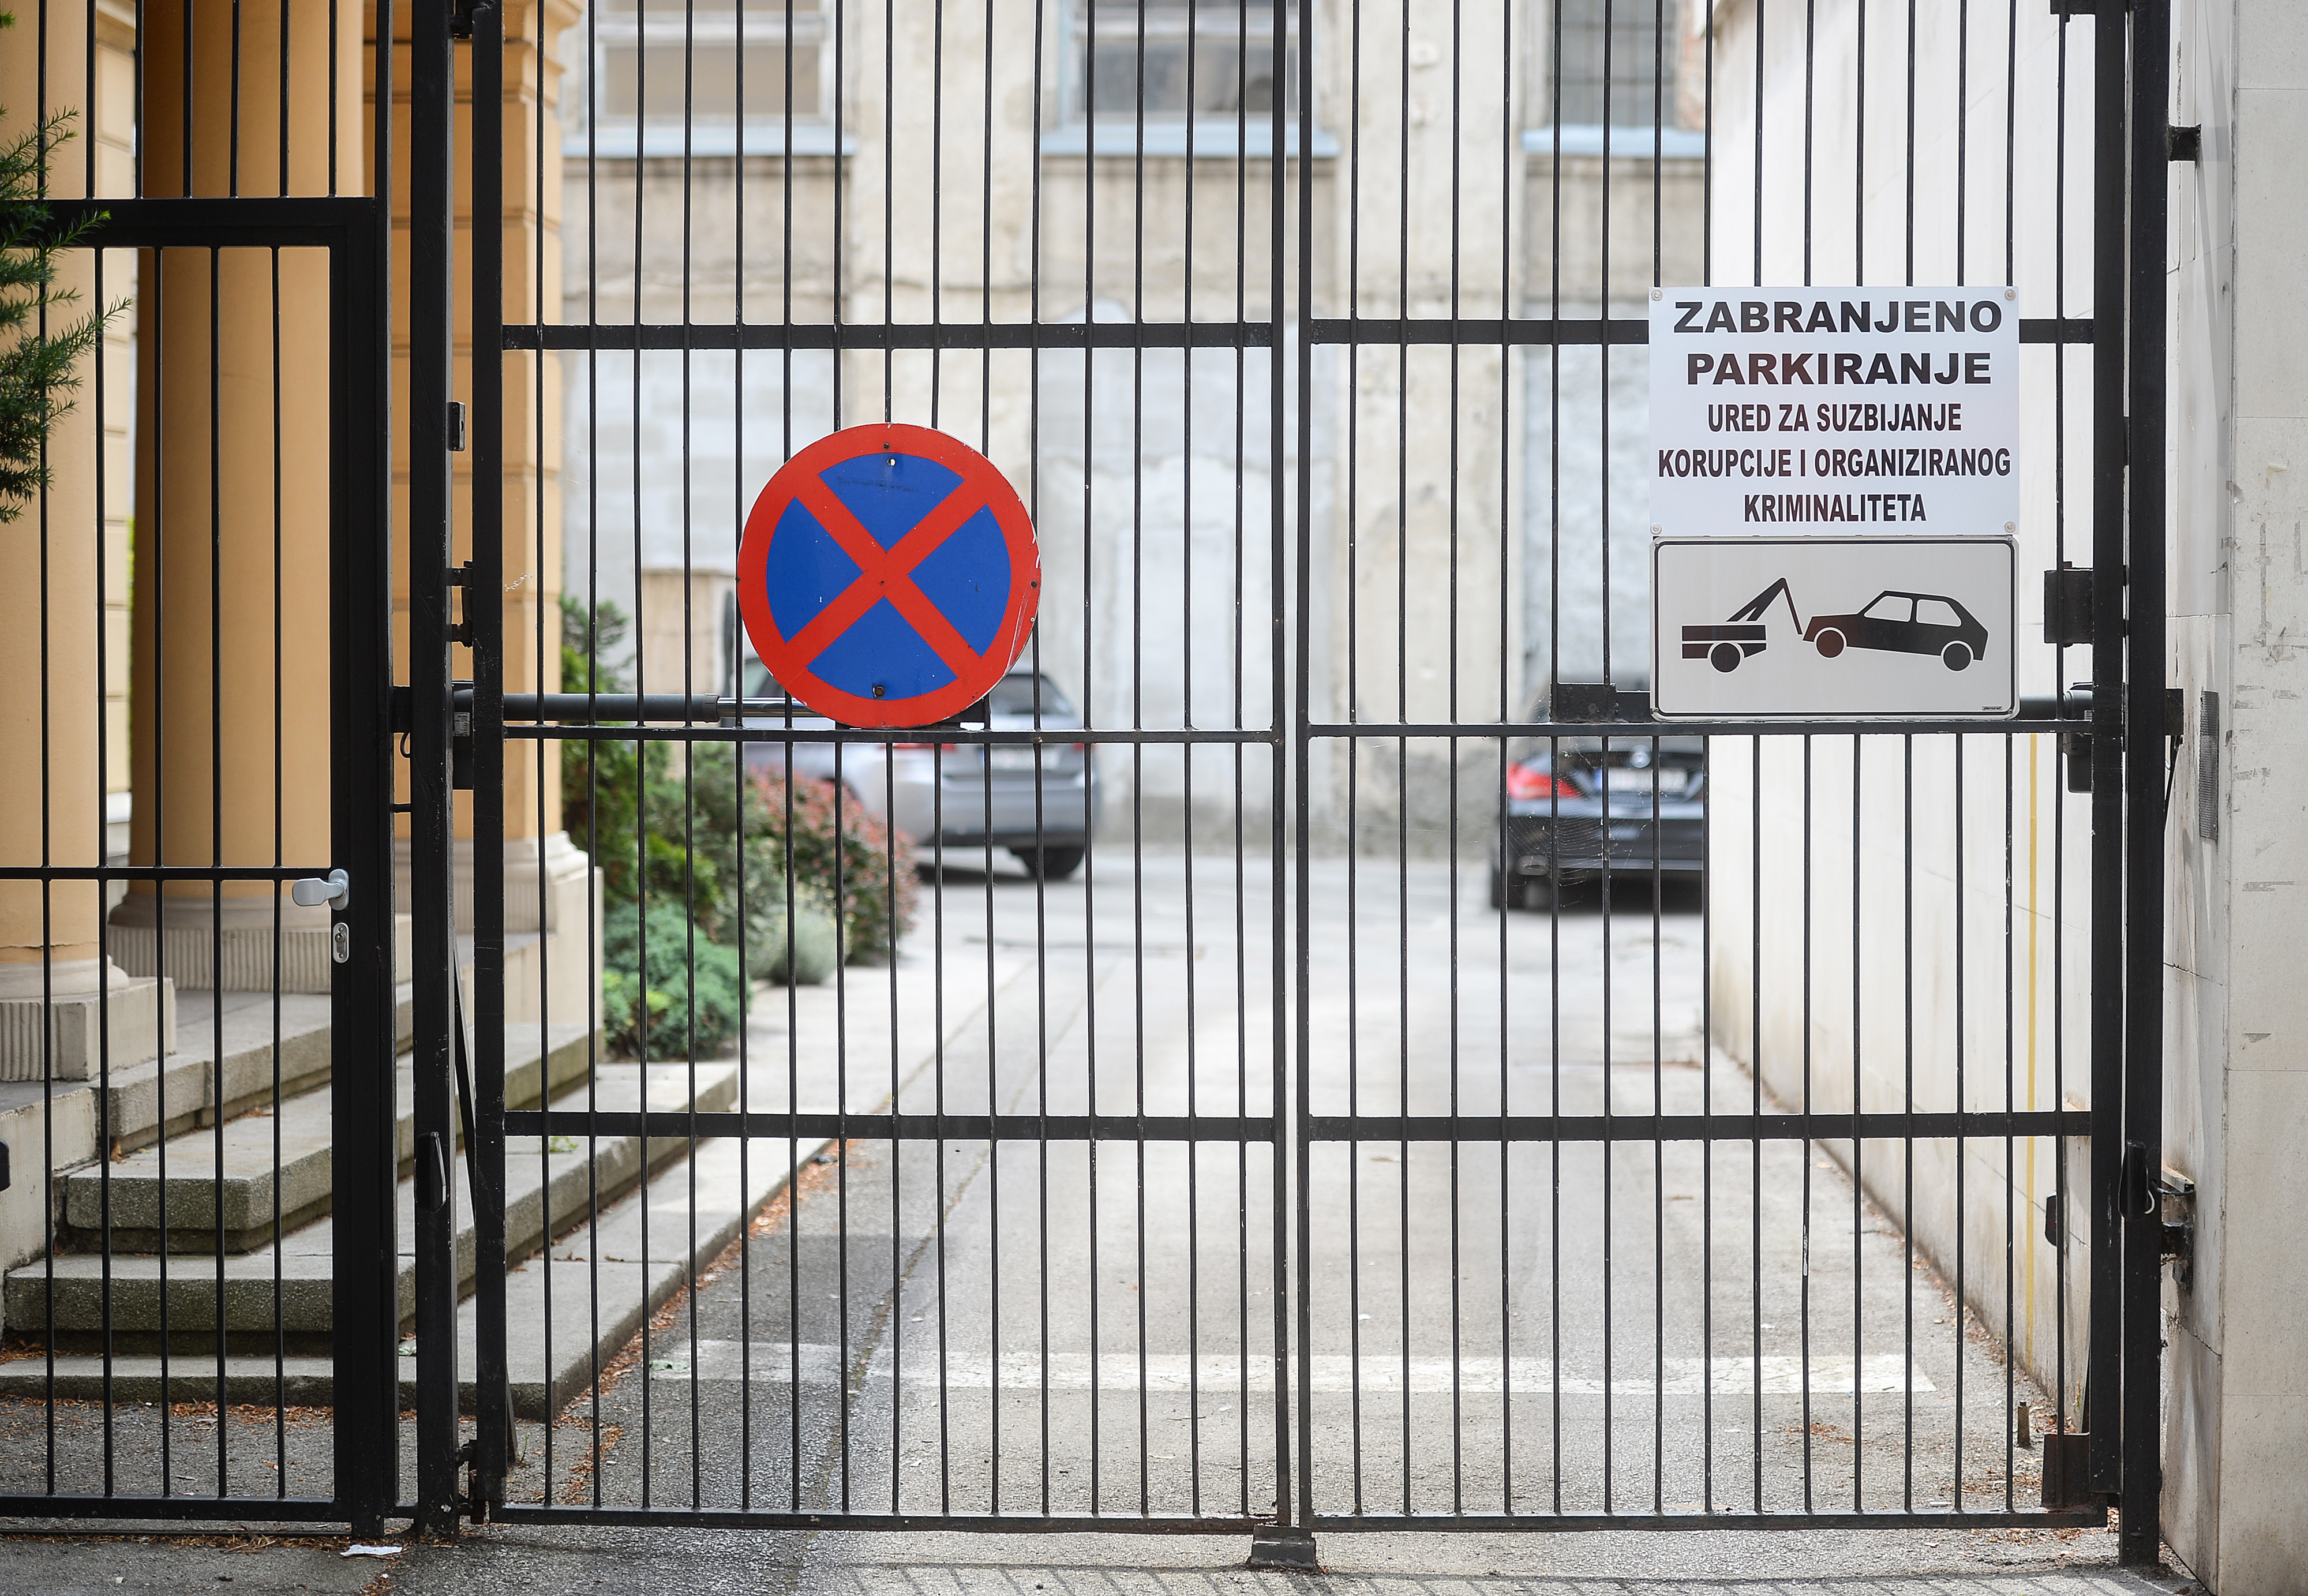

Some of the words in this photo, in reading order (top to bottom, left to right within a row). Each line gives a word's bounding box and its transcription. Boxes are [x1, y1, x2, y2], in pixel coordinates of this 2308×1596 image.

[1674, 300, 2002, 333] ZABRANJENO
[1688, 353, 1991, 385] PARKIRANJE
[1708, 404, 1771, 432] URED
[1778, 404, 1809, 432] ZA
[1816, 403, 1961, 432] SUZBIJANJE
[1659, 449, 1792, 478] KORUPCIJE
[1800, 449, 1805, 477] I
[1815, 448, 2011, 477] ORGANIZIRANOG
[1744, 494, 1927, 522] KRIMINALITETA
